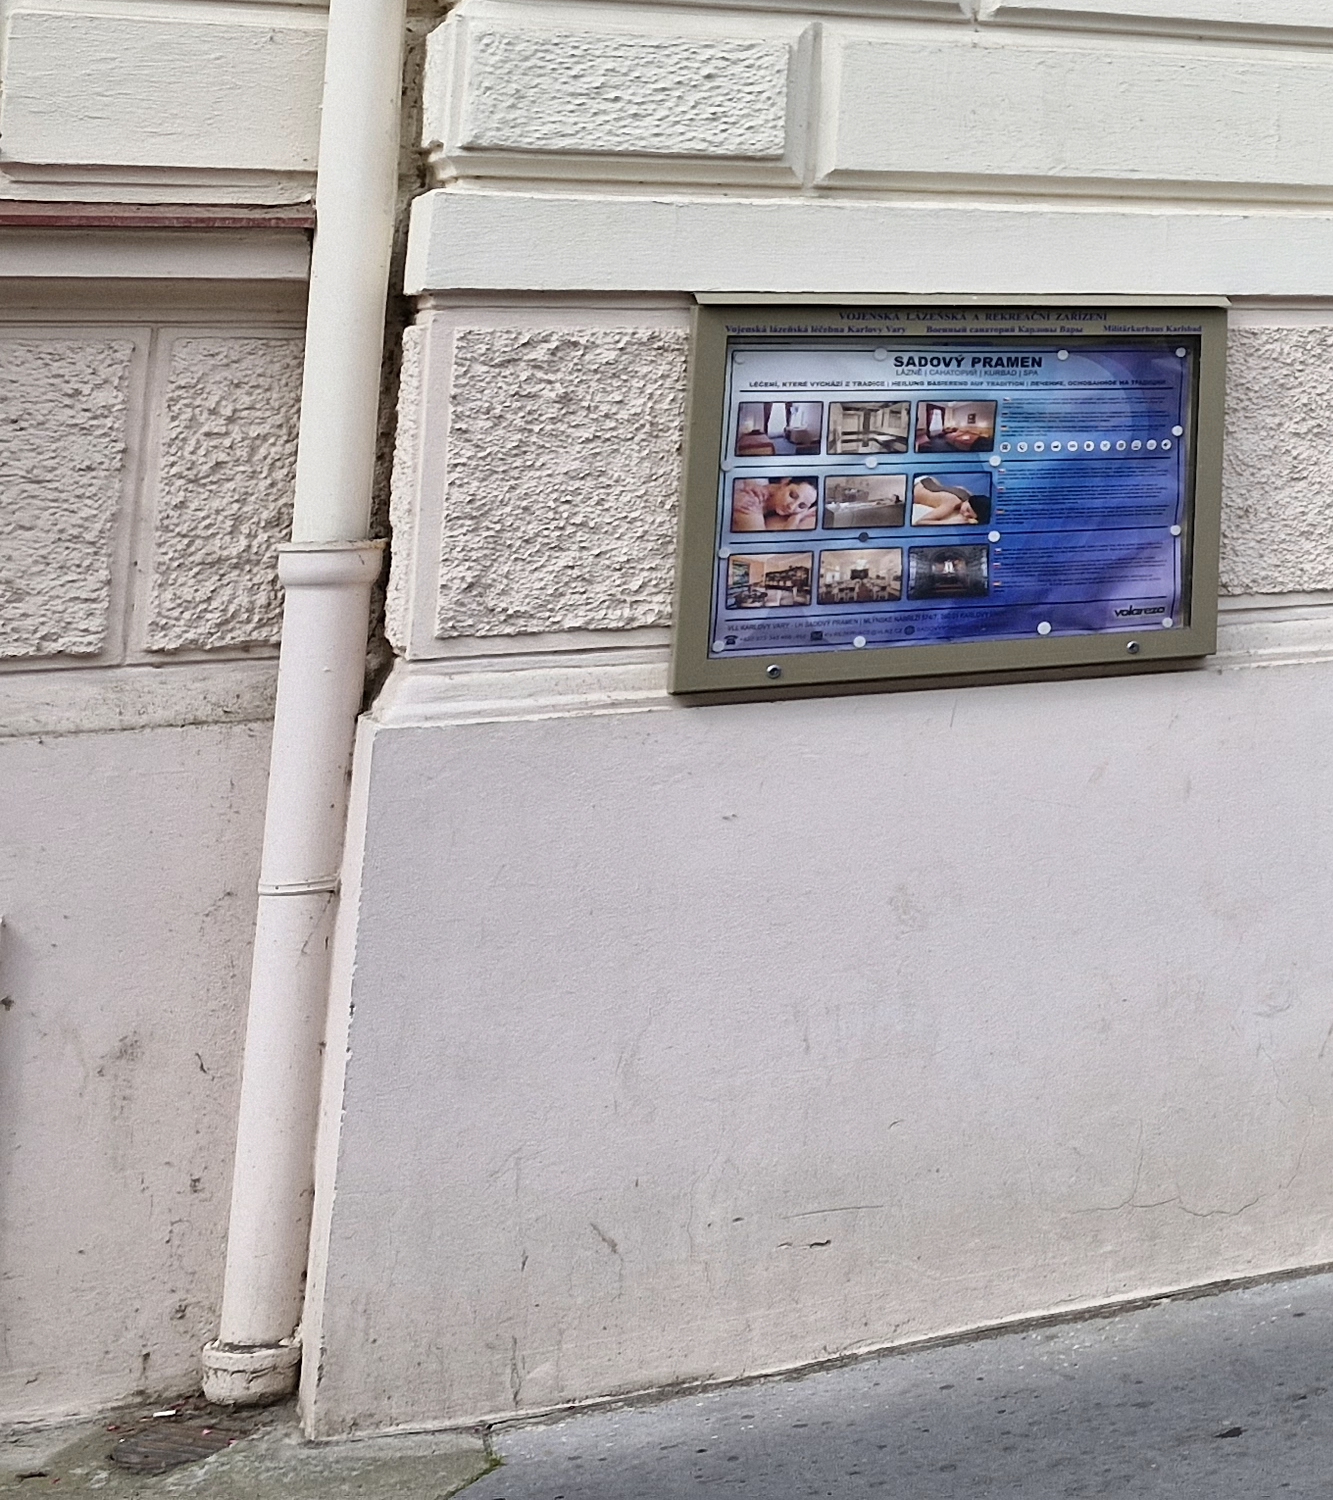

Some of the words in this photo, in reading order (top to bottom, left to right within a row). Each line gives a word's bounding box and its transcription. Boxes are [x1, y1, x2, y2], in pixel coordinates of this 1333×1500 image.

[985, 310, 1050, 320] REKREAČNÍ
[1056, 310, 1107, 320] ZAŘÍZENÍ
[847, 325, 882, 334] Karlovy
[886, 326, 906, 334] Vary
[893, 354, 966, 368] SADOVÝ
[971, 356, 1043, 368] PRAMEN
